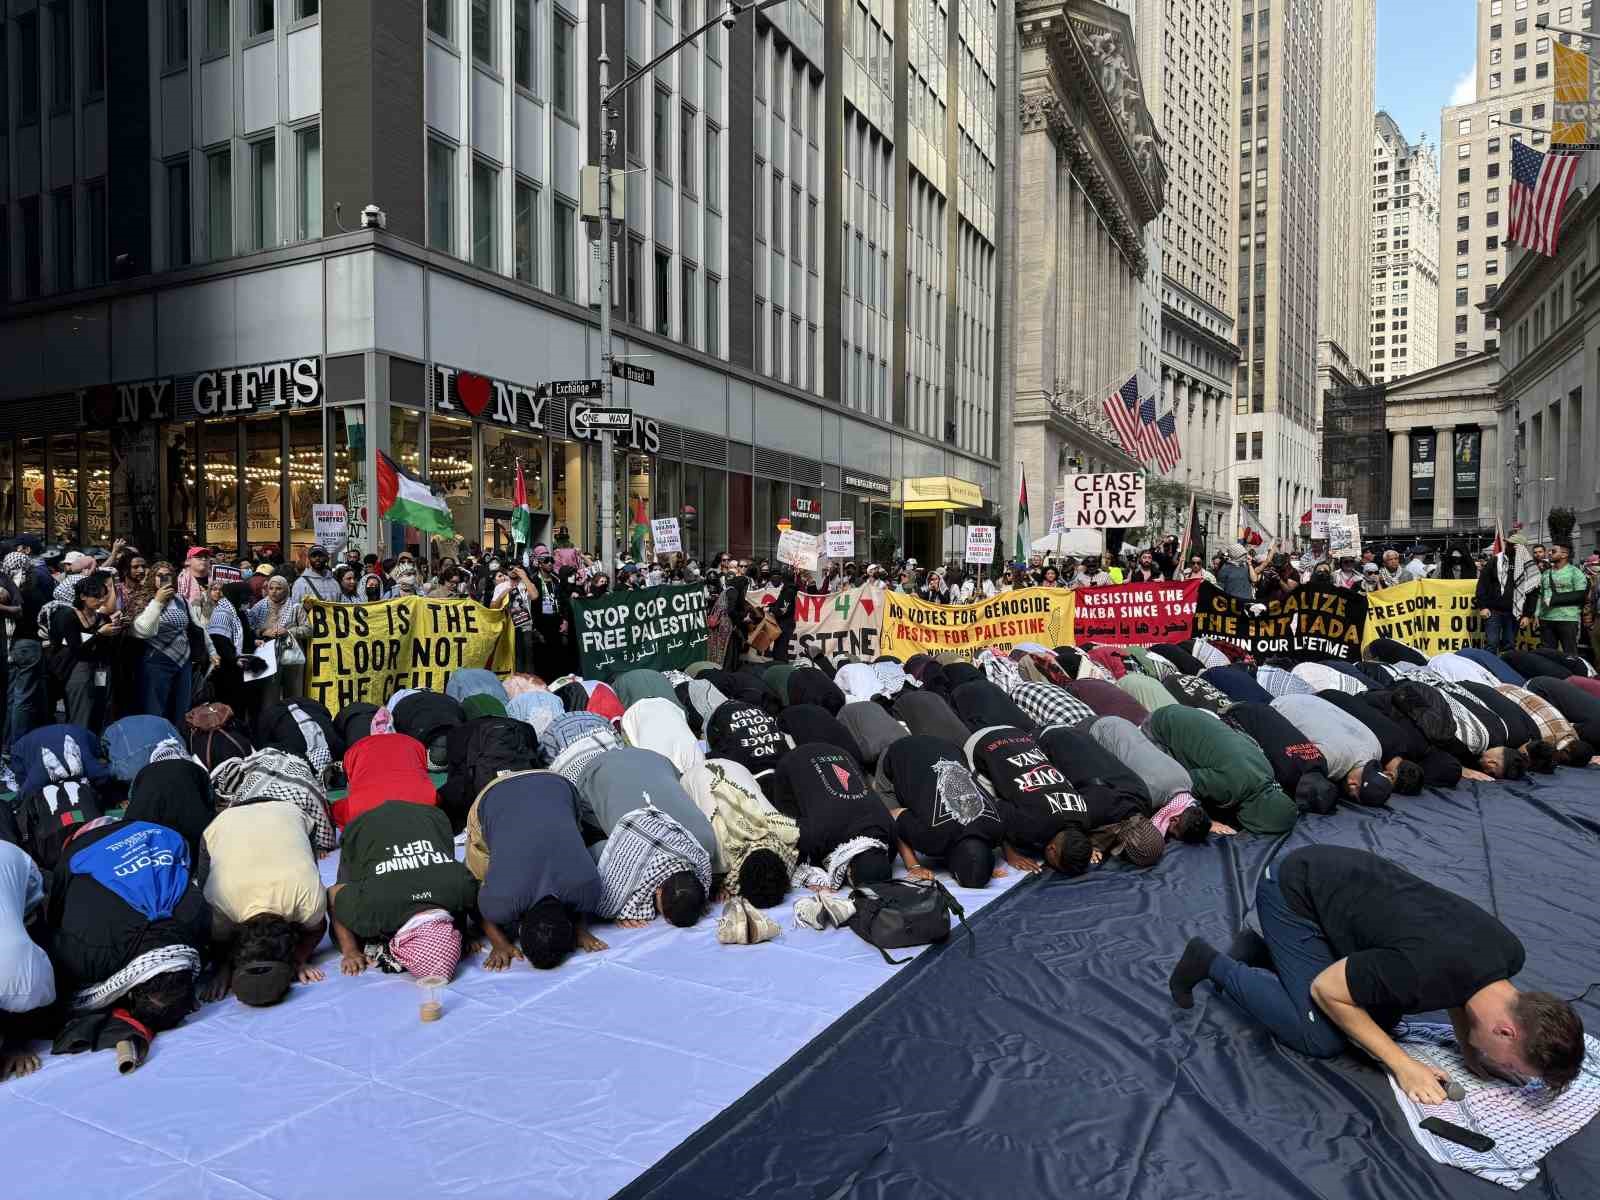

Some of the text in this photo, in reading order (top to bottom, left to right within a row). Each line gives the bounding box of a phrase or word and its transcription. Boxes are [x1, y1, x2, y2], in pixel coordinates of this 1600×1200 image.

[627, 367, 645, 382] Broad
[193, 359, 318, 415] GIFTS
[437, 366, 545, 429] I NY
[556, 383, 590, 396] Exchange
[582, 413, 628, 425] ONE WAY
[1074, 473, 1143, 492] CEASE
[1083, 491, 1137, 509] FIRE
[1077, 509, 1137, 526] NOW
[794, 594, 851, 623] NY 4
[1083, 589, 1184, 606] RESISTING THE
[1212, 591, 1347, 618] GLBALIZE
[313, 604, 369, 638] BDS
[387, 604, 410, 635] IS
[427, 603, 478, 633] THE
[582, 604, 630, 629] STOP
[634, 597, 668, 621] COP
[908, 610, 947, 626] VOTES
[953, 609, 977, 625] FOR
[984, 597, 1051, 619] GENOCIDE
[1120, 604, 1158, 618] SINCE
[582, 609, 709, 653] FREE PALESTIN
[896, 617, 1045, 644] RESIST FOR PALESTINE
[1195, 612, 1237, 635] THE
[313, 636, 467, 676] FLOOR NOT
[1257, 638, 1289, 653] OUR
[312, 676, 371, 715] THE
[741, 732, 780, 747] PEACE
[748, 724, 768, 736] ON
[754, 744, 775, 757] NO
[1013, 767, 1064, 792] OVER
[385, 840, 434, 857] DEPT.
[375, 851, 454, 875] TRAINING
